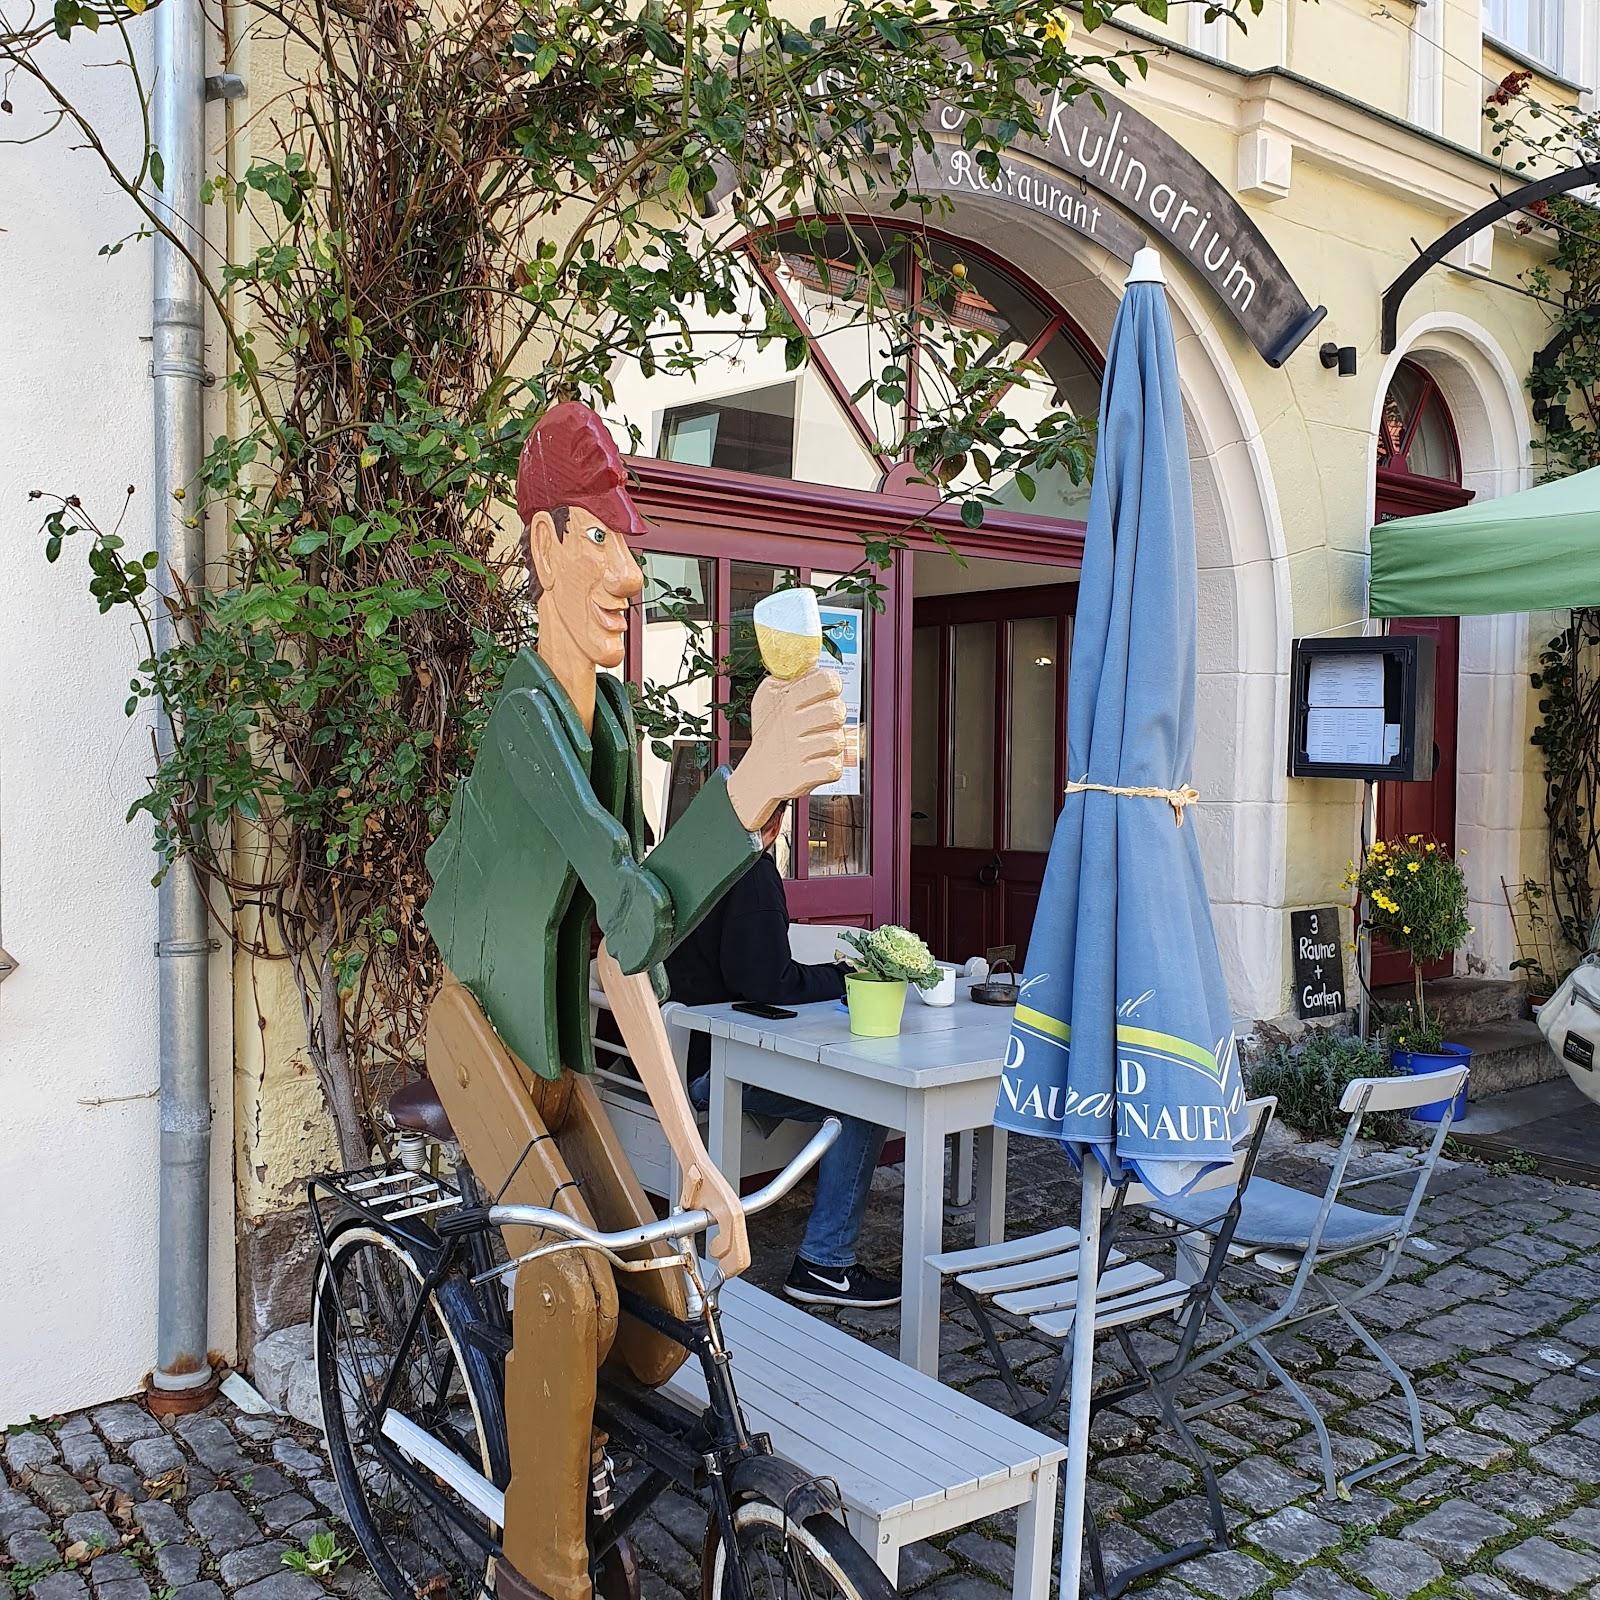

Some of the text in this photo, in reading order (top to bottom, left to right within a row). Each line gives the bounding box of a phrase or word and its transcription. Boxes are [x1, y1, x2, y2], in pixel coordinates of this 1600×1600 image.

[949, 150, 1101, 233] Restaurant
[1045, 78, 1257, 312] Kulinarium
[1299, 936, 1336, 960] Räume
[1310, 914, 1319, 935] 3
